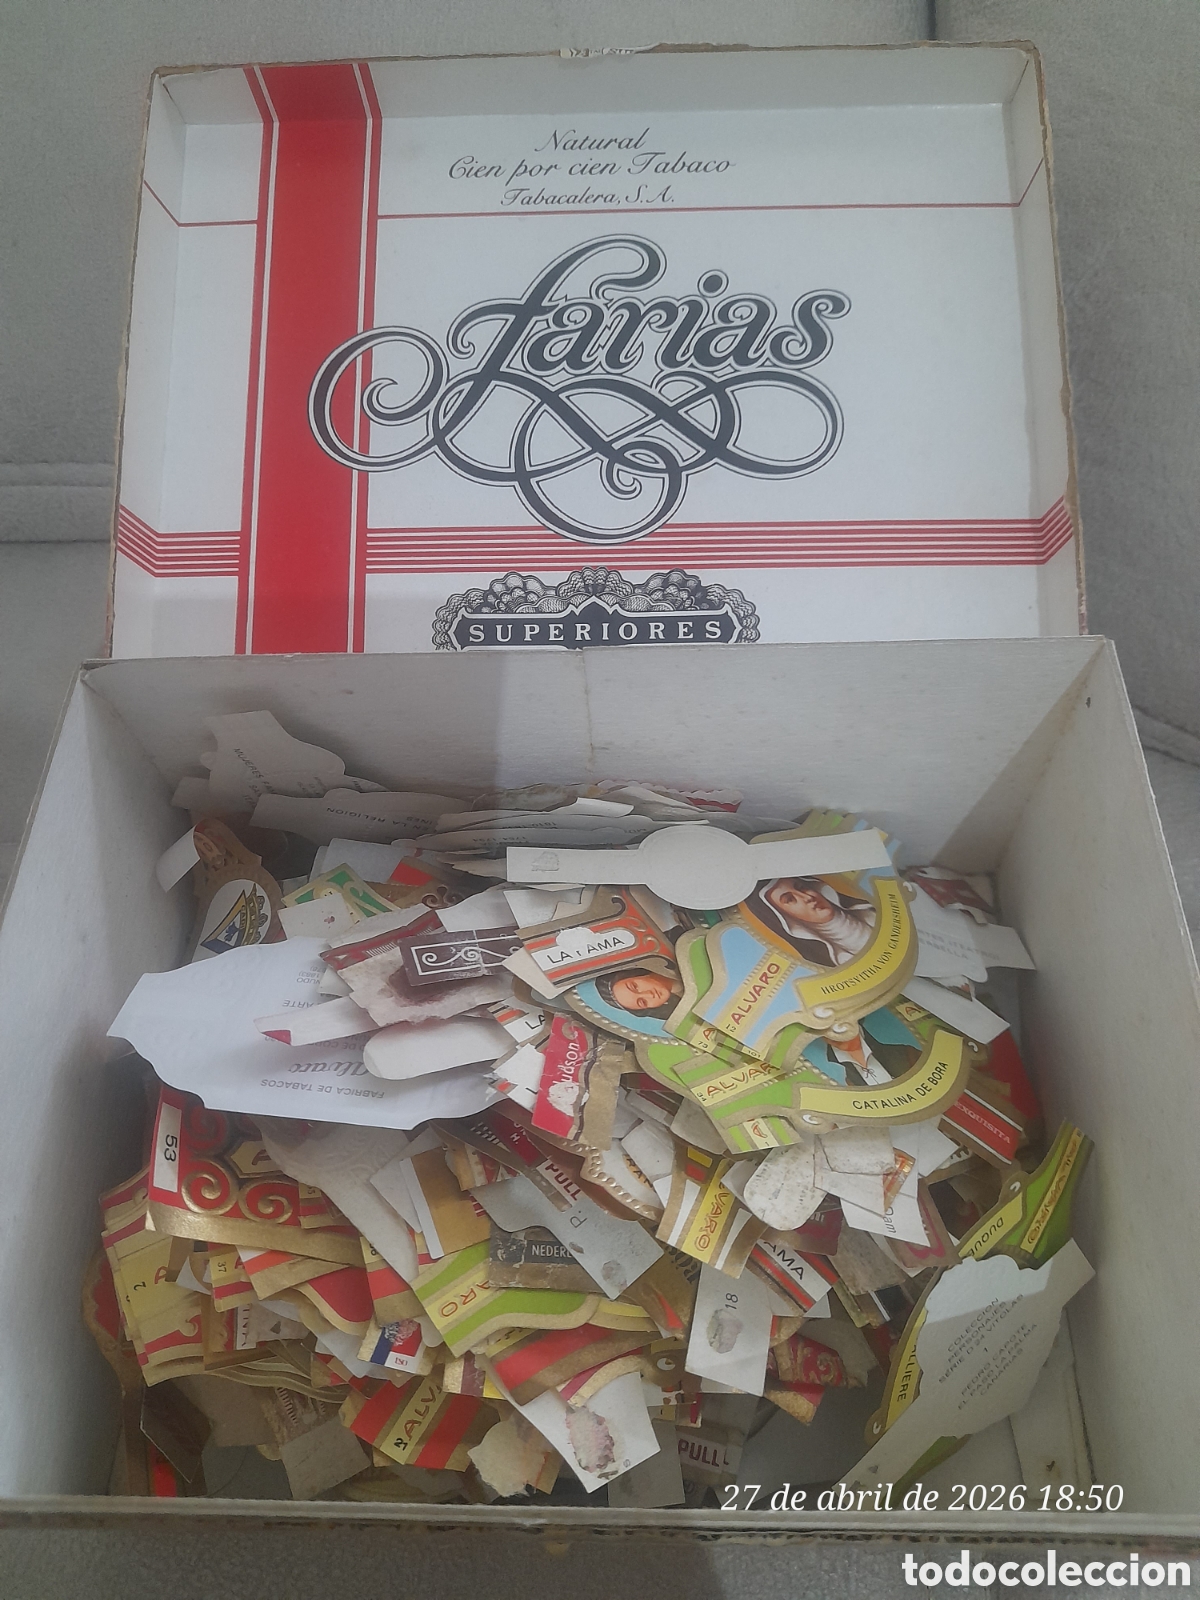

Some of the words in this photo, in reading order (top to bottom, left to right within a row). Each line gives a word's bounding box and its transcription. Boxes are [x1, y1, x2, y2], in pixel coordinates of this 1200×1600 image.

[534, 127, 651, 152] Natural
[449, 155, 505, 179] Cien
[505, 158, 561, 187] por
[568, 157, 621, 177] cien
[627, 151, 736, 176] Tabaco
[500, 186, 622, 206] Tabacalera,
[625, 184, 675, 204] S.A.
[468, 620, 723, 642] SUPERIORES
[326, 807, 386, 823] RELIGION
[547, 949, 574, 965] LA
[820, 964, 882, 995] HROTSVITHA
[876, 949, 893, 966] VON
[887, 893, 902, 951] GANDERSHEIM
[730, 962, 781, 1025] ALVARO
[560, 1041, 580, 1084] udson
[706, 1060, 780, 1097] ALVAR
[260, 1078, 313, 1092] TABACOS
[317, 1084, 333, 1094] DE
[336, 1086, 386, 1099] FABRICA
[852, 1092, 917, 1111] CATALINA
[915, 1081, 932, 1097] DE
[928, 1060, 949, 1086] BORA
[953, 1100, 1012, 1145] EXQUISITA
[163, 1134, 178, 1163] 53
[694, 1184, 731, 1252] VARO
[217, 1260, 227, 1273] 37
[939, 1356, 965, 1384] SERIE
[986, 1293, 1024, 1332] VITOLAS
[947, 1297, 999, 1353] COLECCION
[947, 1301, 1007, 1364] PERSONAJES
[1007, 1323, 1038, 1355] PALMA
[961, 1362, 991, 1396] PEDRO
[992, 1323, 1027, 1361] CAPOTE
[980, 1347, 1024, 1396] CANARIAS
[678, 1438, 720, 1468] PULL
